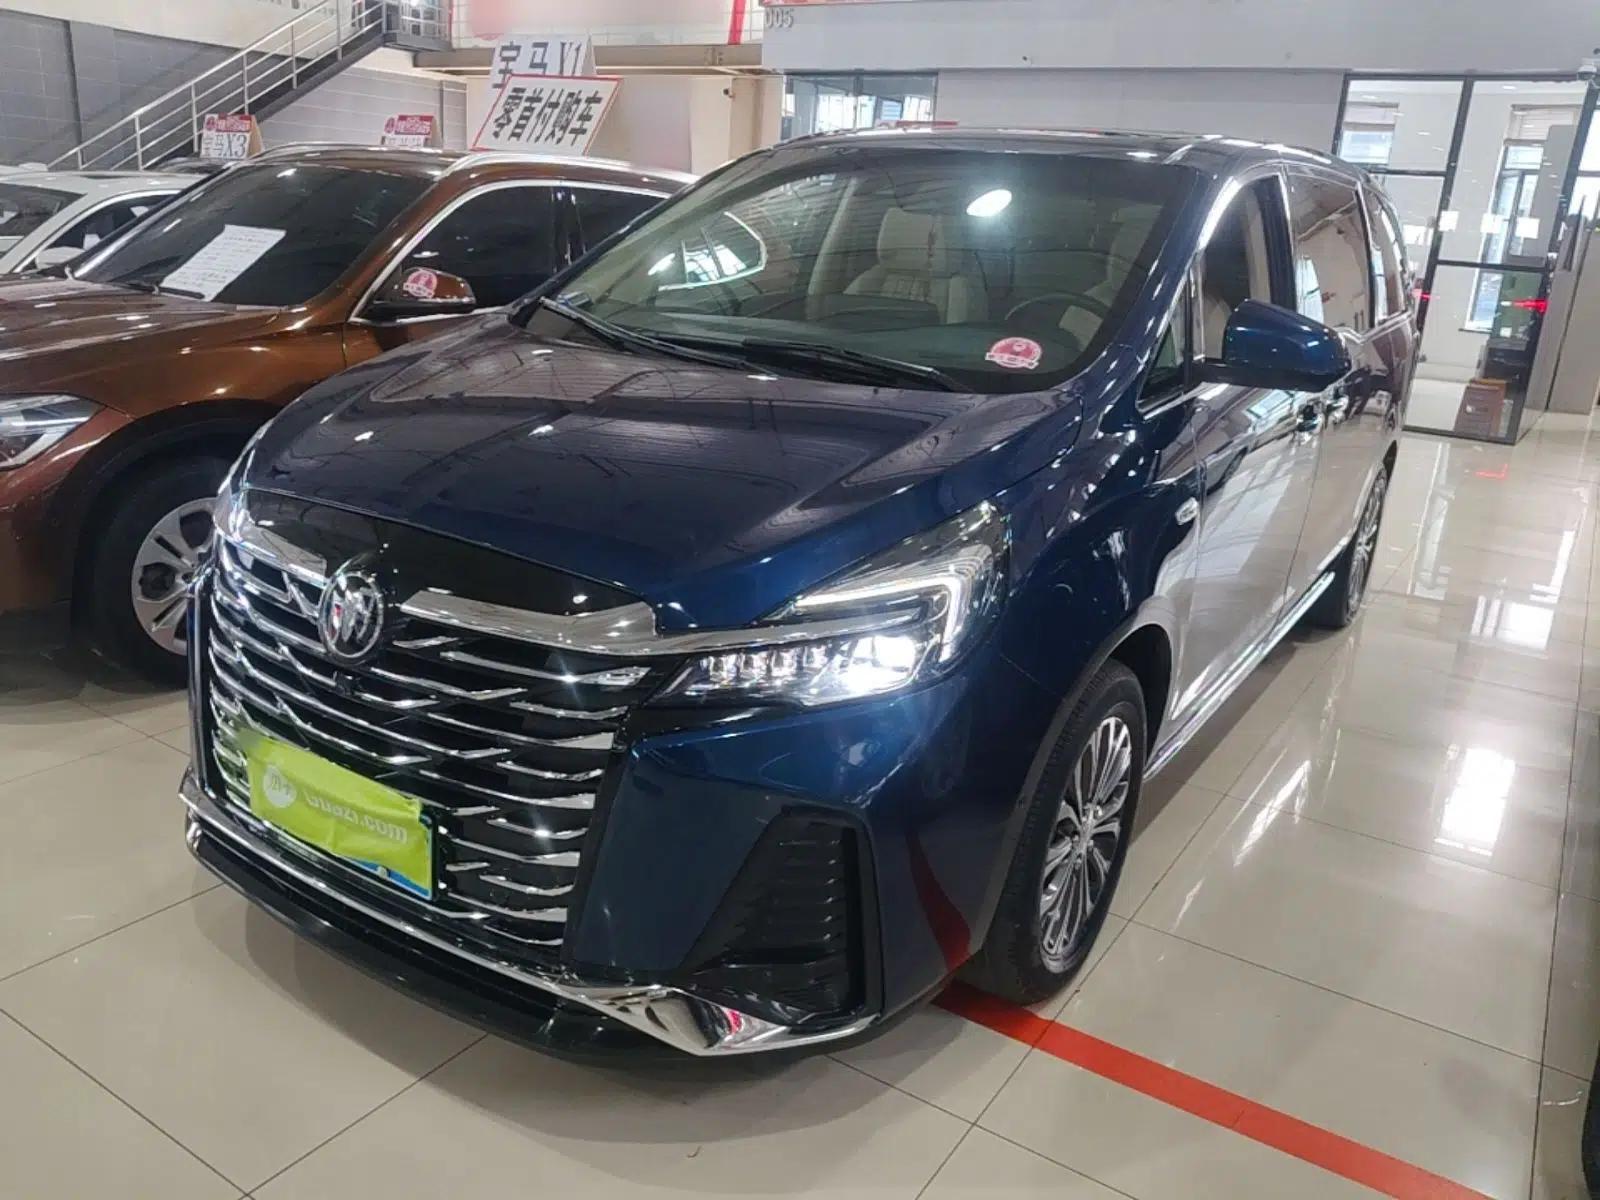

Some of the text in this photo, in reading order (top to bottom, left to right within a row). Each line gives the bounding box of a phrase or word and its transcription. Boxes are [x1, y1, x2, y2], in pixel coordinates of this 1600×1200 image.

[492, 86, 603, 147] 零首付购车
